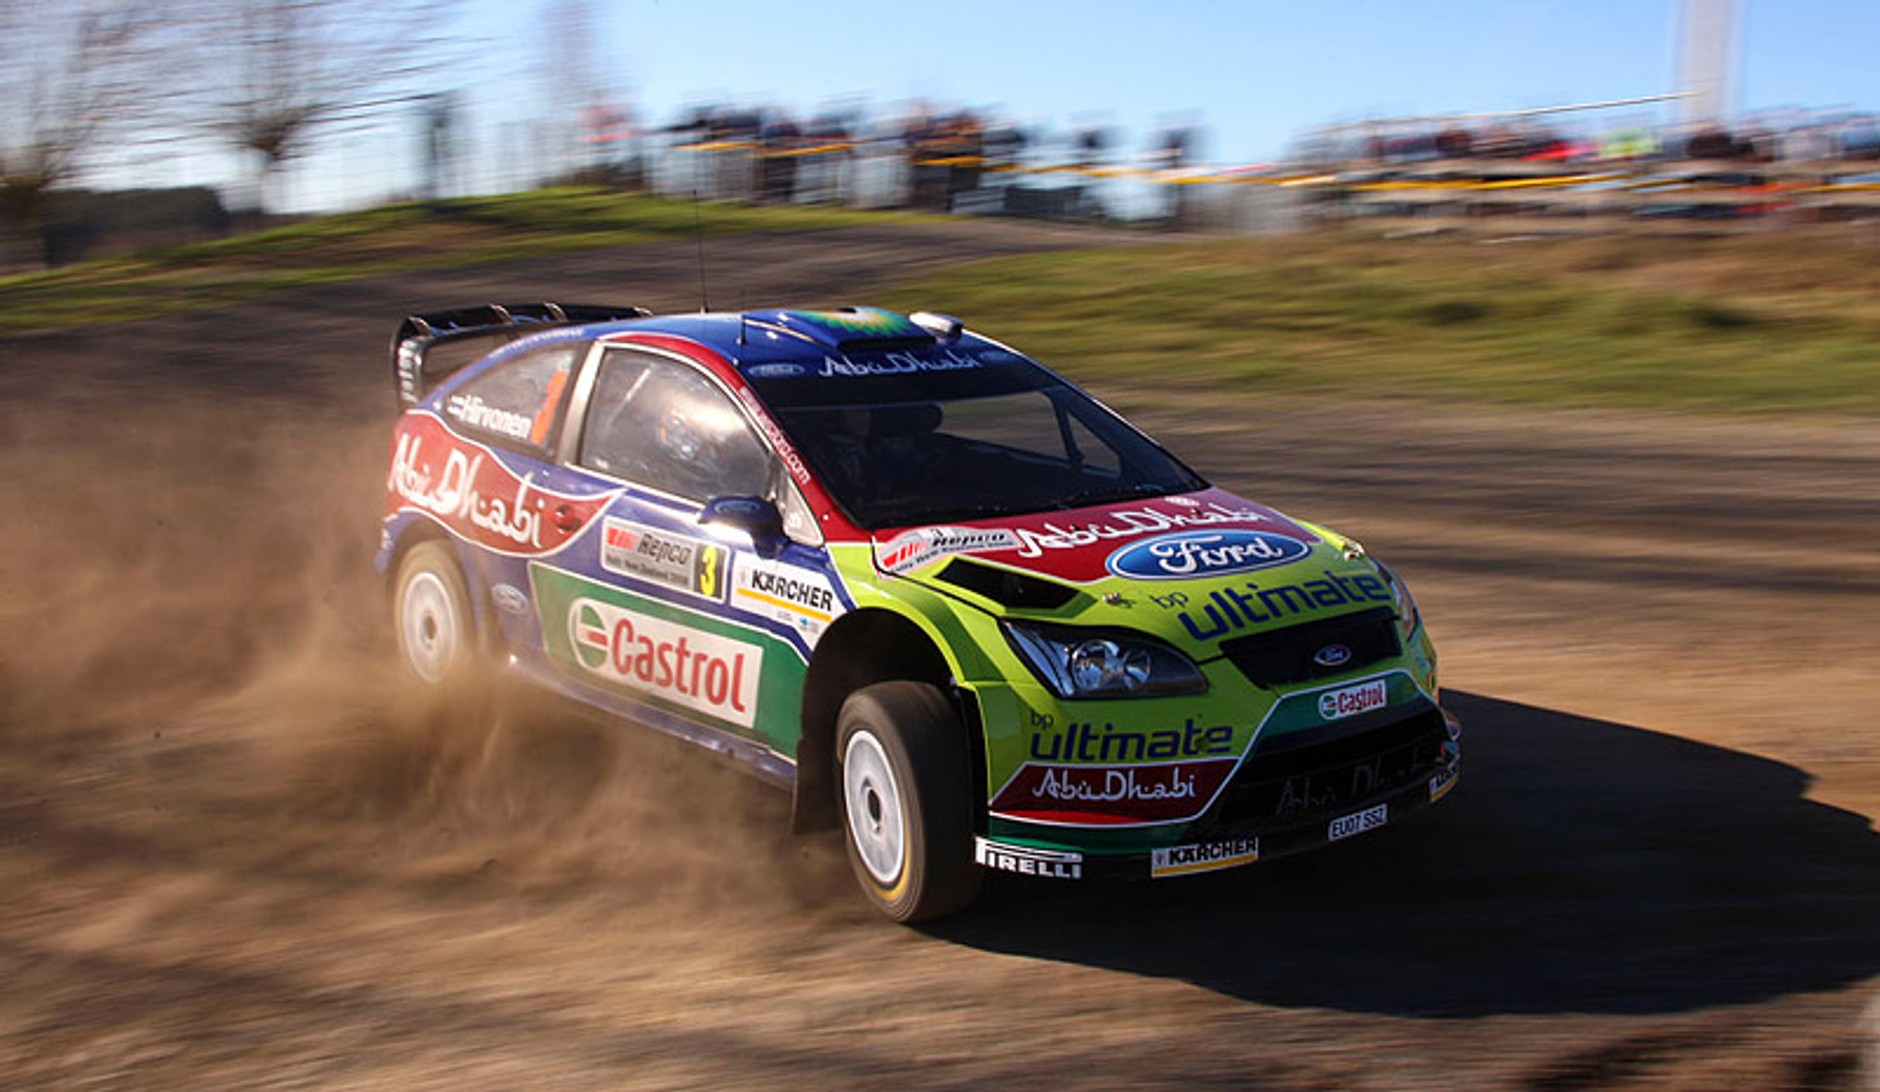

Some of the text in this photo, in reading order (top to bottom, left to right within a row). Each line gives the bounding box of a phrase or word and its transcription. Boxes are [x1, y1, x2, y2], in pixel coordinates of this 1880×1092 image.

[463, 395, 532, 438] Hirvonen
[637, 531, 692, 565] Repco
[932, 533, 1005, 547] Repco
[1149, 534, 1283, 573] Ford
[700, 544, 718, 597] 3
[751, 569, 833, 611] KÄRCHER
[1149, 591, 1189, 609] bp
[1177, 570, 1392, 641] ultimate
[611, 618, 746, 713] Castrol
[1336, 683, 1384, 714] Castrol
[1029, 717, 1233, 761] ultimate
[1030, 709, 1054, 730] bp
[1032, 766, 1196, 801] Abu Dhabi
[975, 835, 1083, 879] PIRELLI
